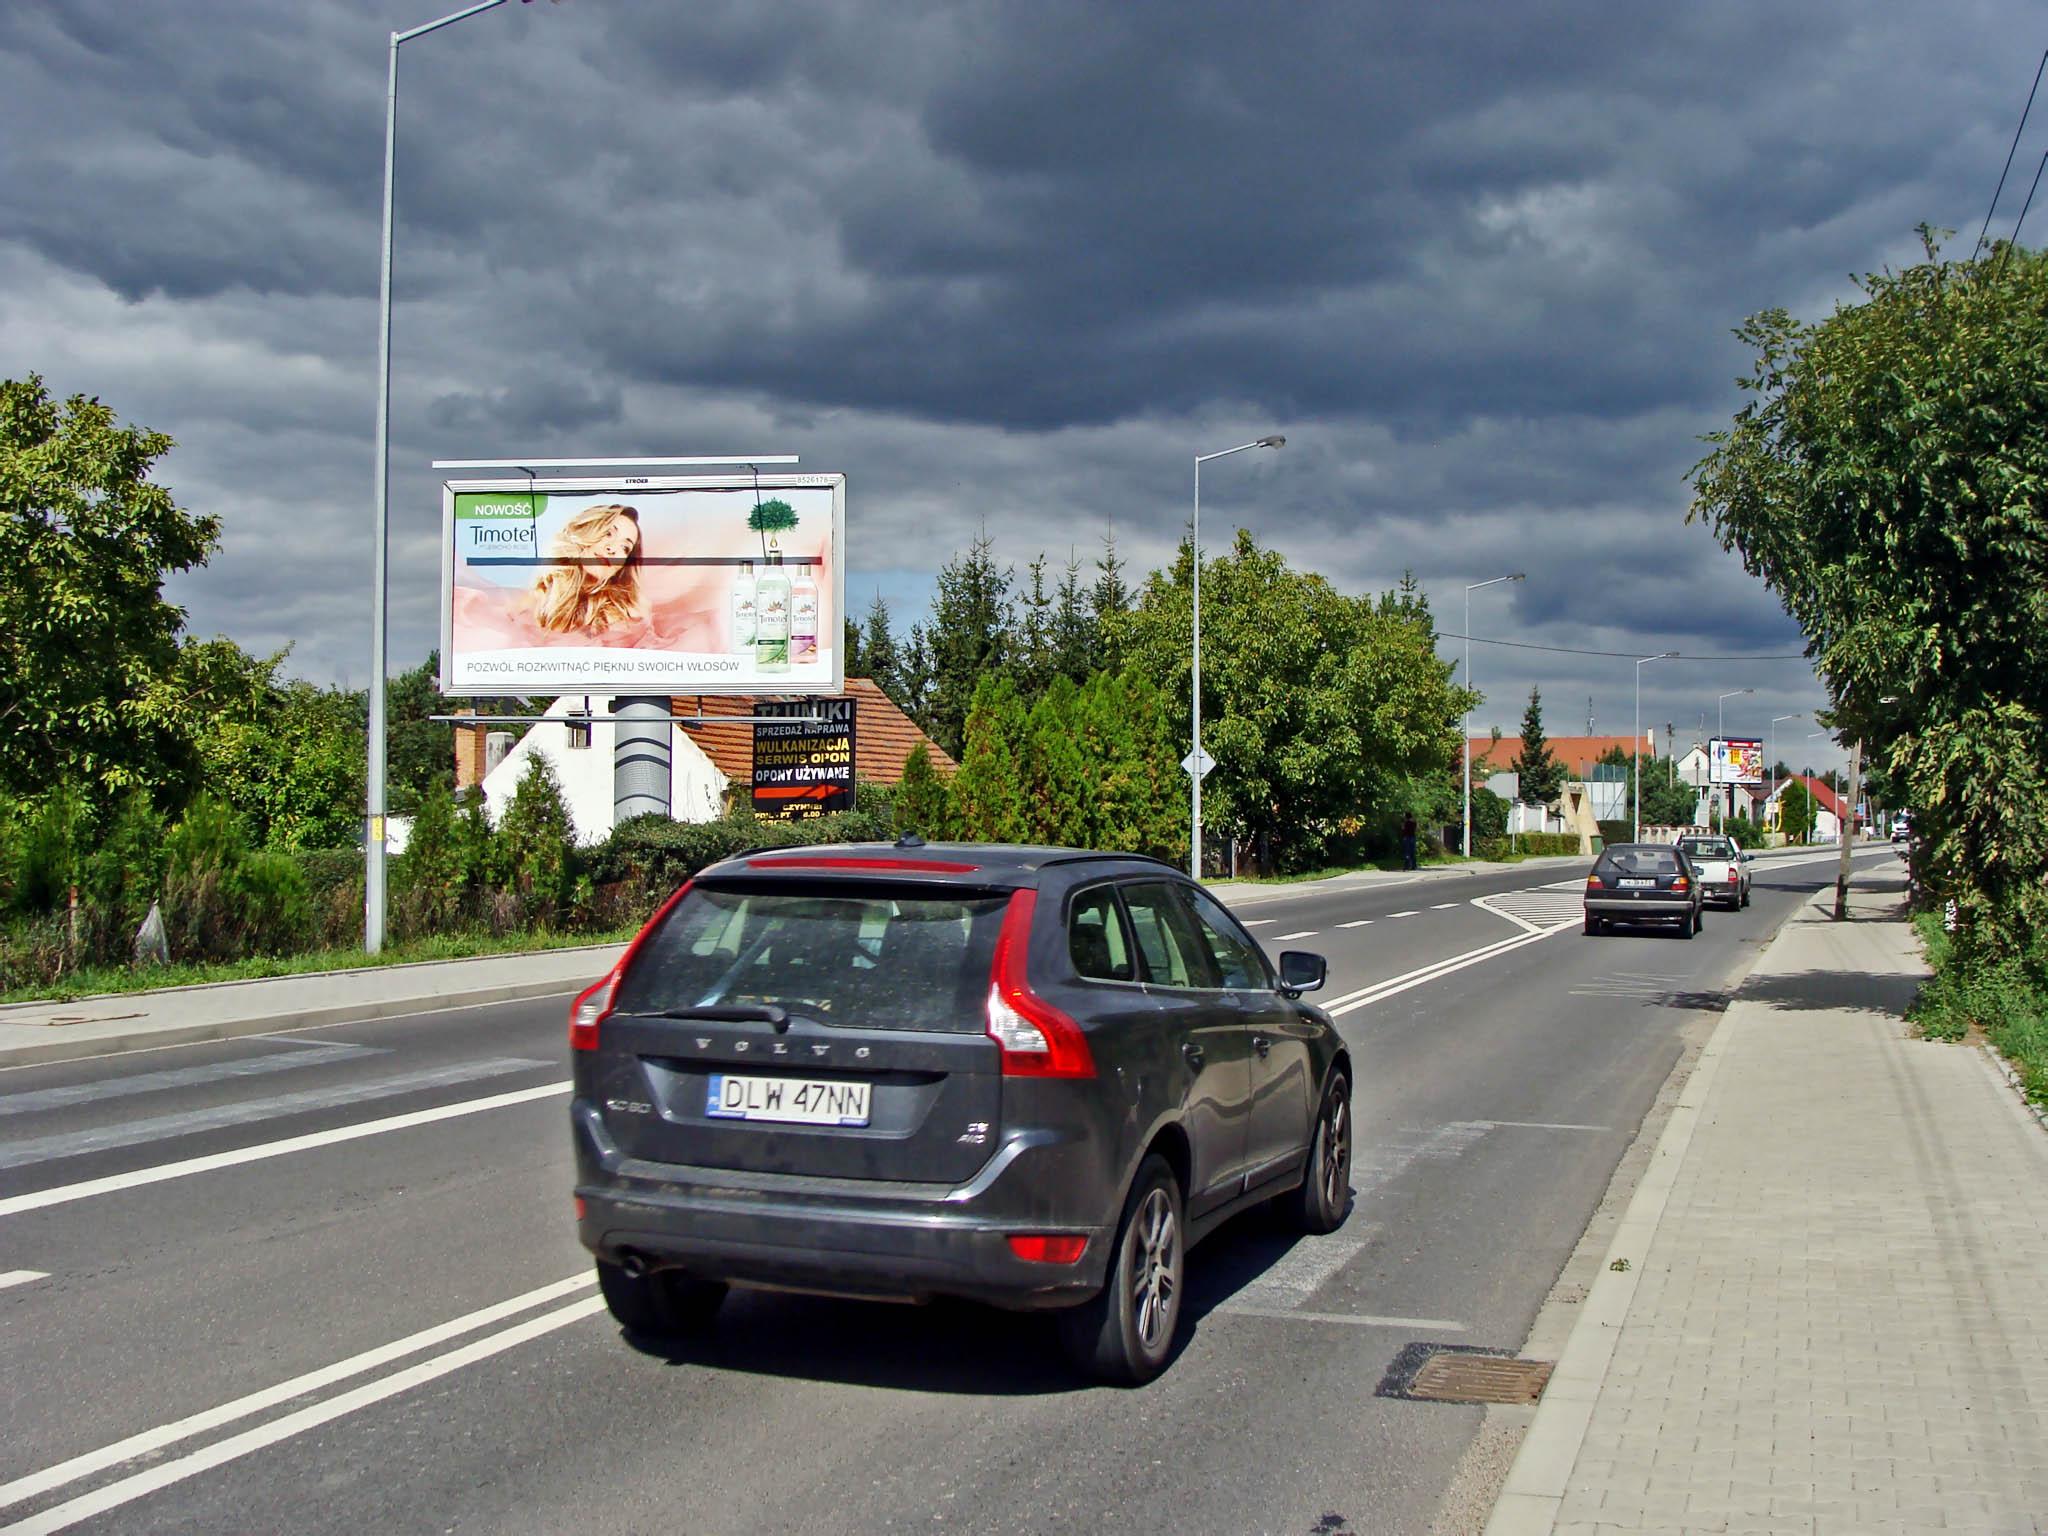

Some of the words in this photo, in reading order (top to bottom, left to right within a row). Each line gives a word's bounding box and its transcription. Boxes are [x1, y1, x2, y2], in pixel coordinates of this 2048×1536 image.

[474, 502, 531, 516] NOWOŚĆ
[469, 525, 536, 545] Timotei
[467, 661, 514, 672] POZWÓL
[517, 660, 591, 674] ROZKWITNĄĆ
[593, 661, 635, 674] PIĘKNU
[638, 661, 684, 672] SWOICH
[687, 660, 740, 671] WŁOSÓW
[757, 738, 849, 753] WULKANIZACJA
[756, 754, 807, 765] SERWIS
[810, 752, 849, 763] OPON
[755, 768, 793, 781] OPONY
[795, 765, 849, 780] UŻYWANE
[696, 1038, 870, 1058] VOLVO
[725, 1080, 784, 1110] DLW
[794, 1083, 863, 1115] 47NN
